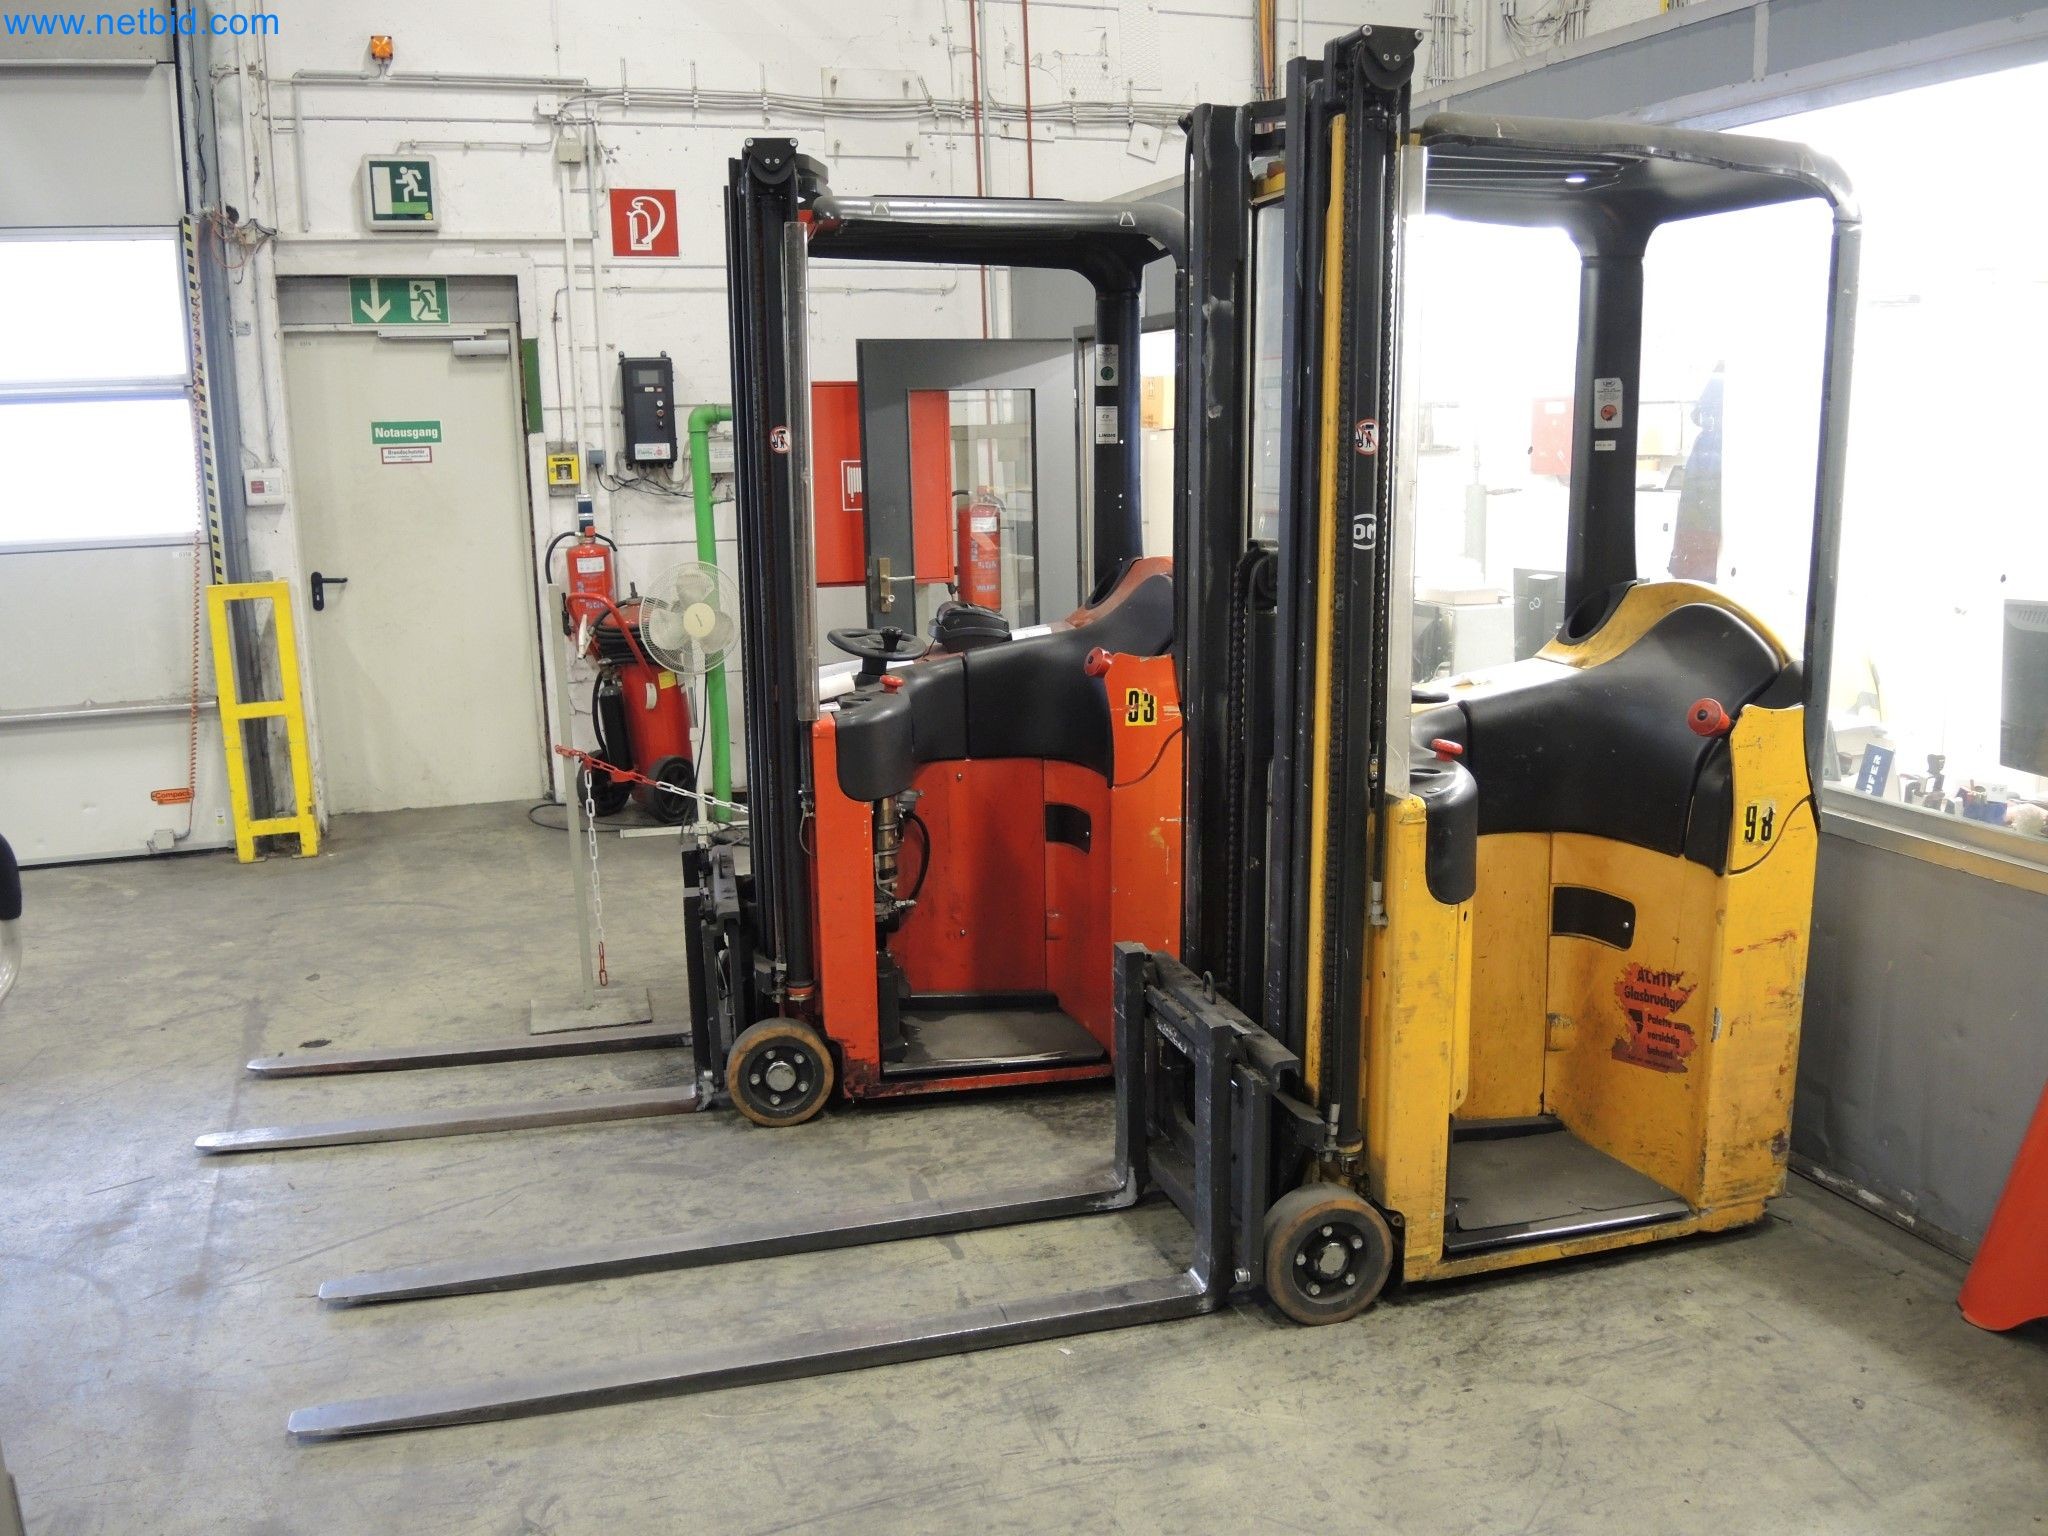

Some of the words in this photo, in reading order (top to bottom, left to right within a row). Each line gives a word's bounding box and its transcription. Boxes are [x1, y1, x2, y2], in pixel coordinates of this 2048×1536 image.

[374, 427, 439, 440] Notausgang
[1744, 805, 1773, 842] 98
[1647, 1032, 1680, 1048] vorsichtig
